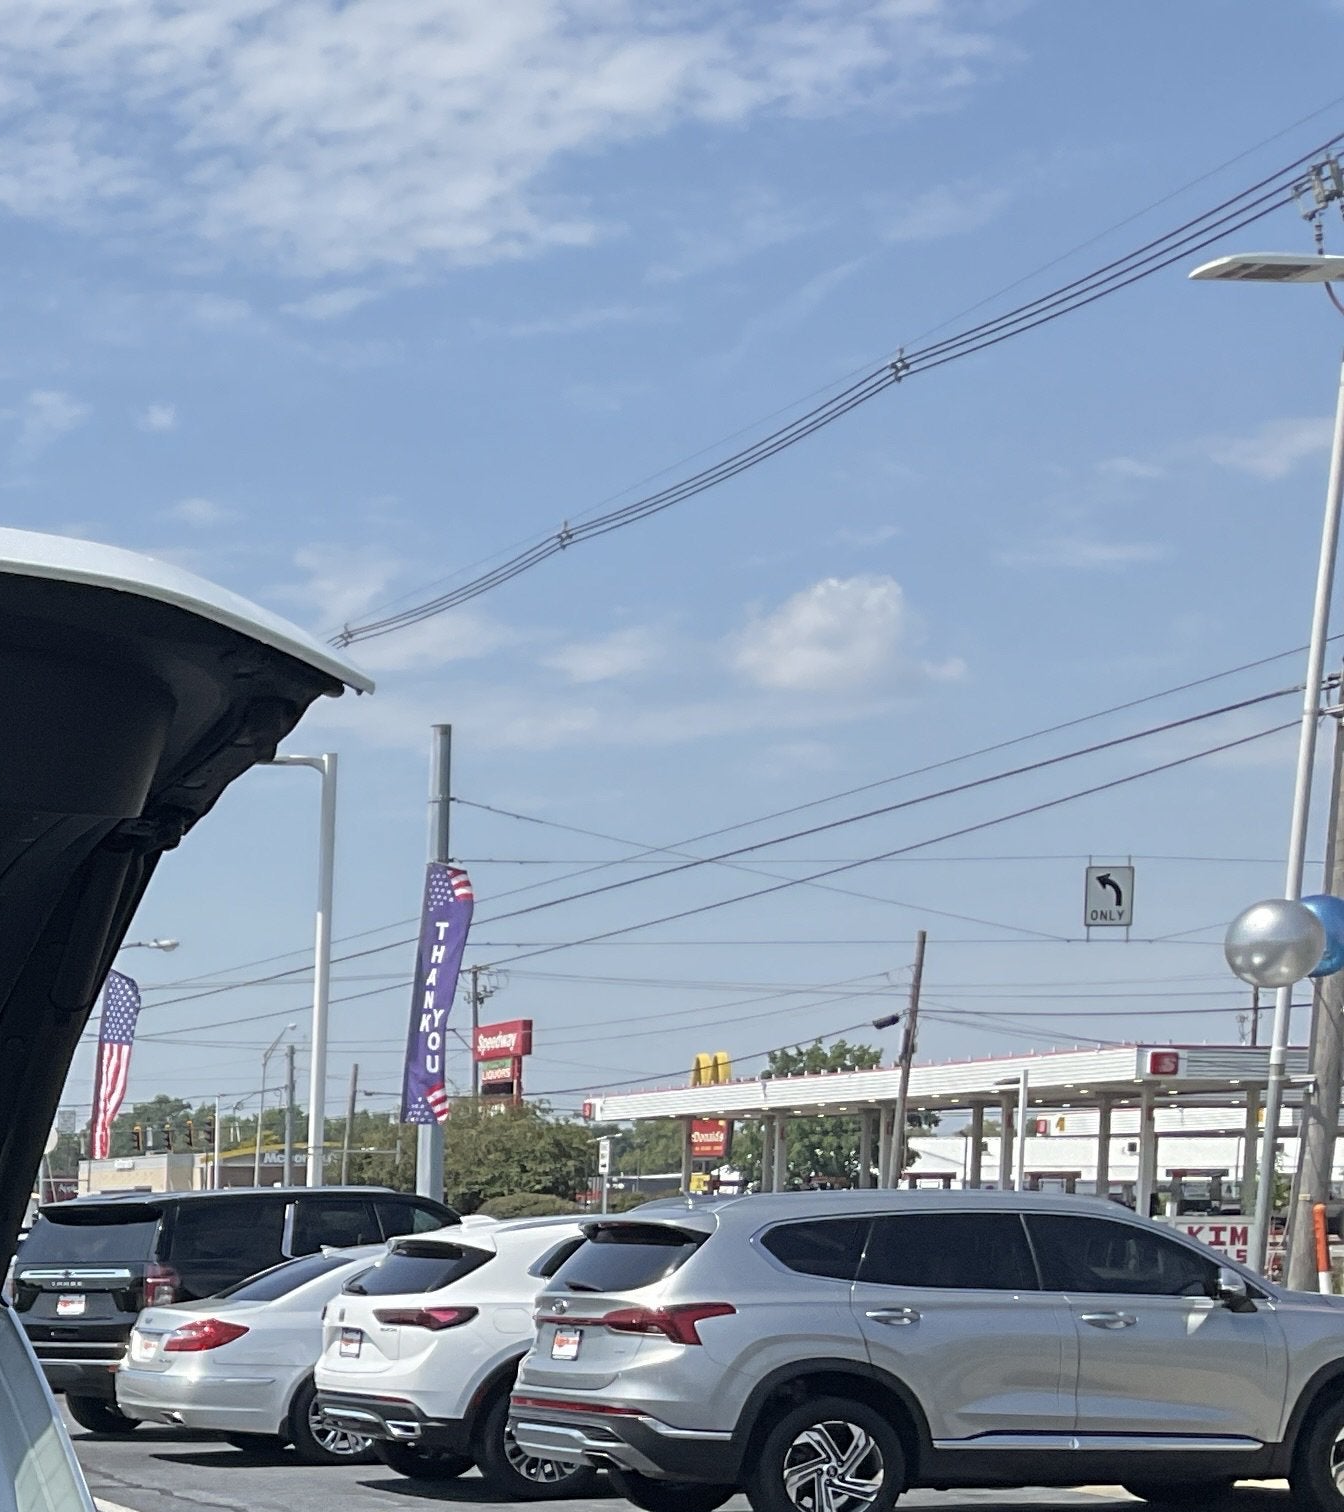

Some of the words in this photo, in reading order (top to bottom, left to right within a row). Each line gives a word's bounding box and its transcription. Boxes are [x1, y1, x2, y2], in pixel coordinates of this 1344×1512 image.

[1090, 909, 1125, 921] ONLY
[477, 1030, 518, 1055] Speedway
[481, 1067, 511, 1081] LIQUORS
